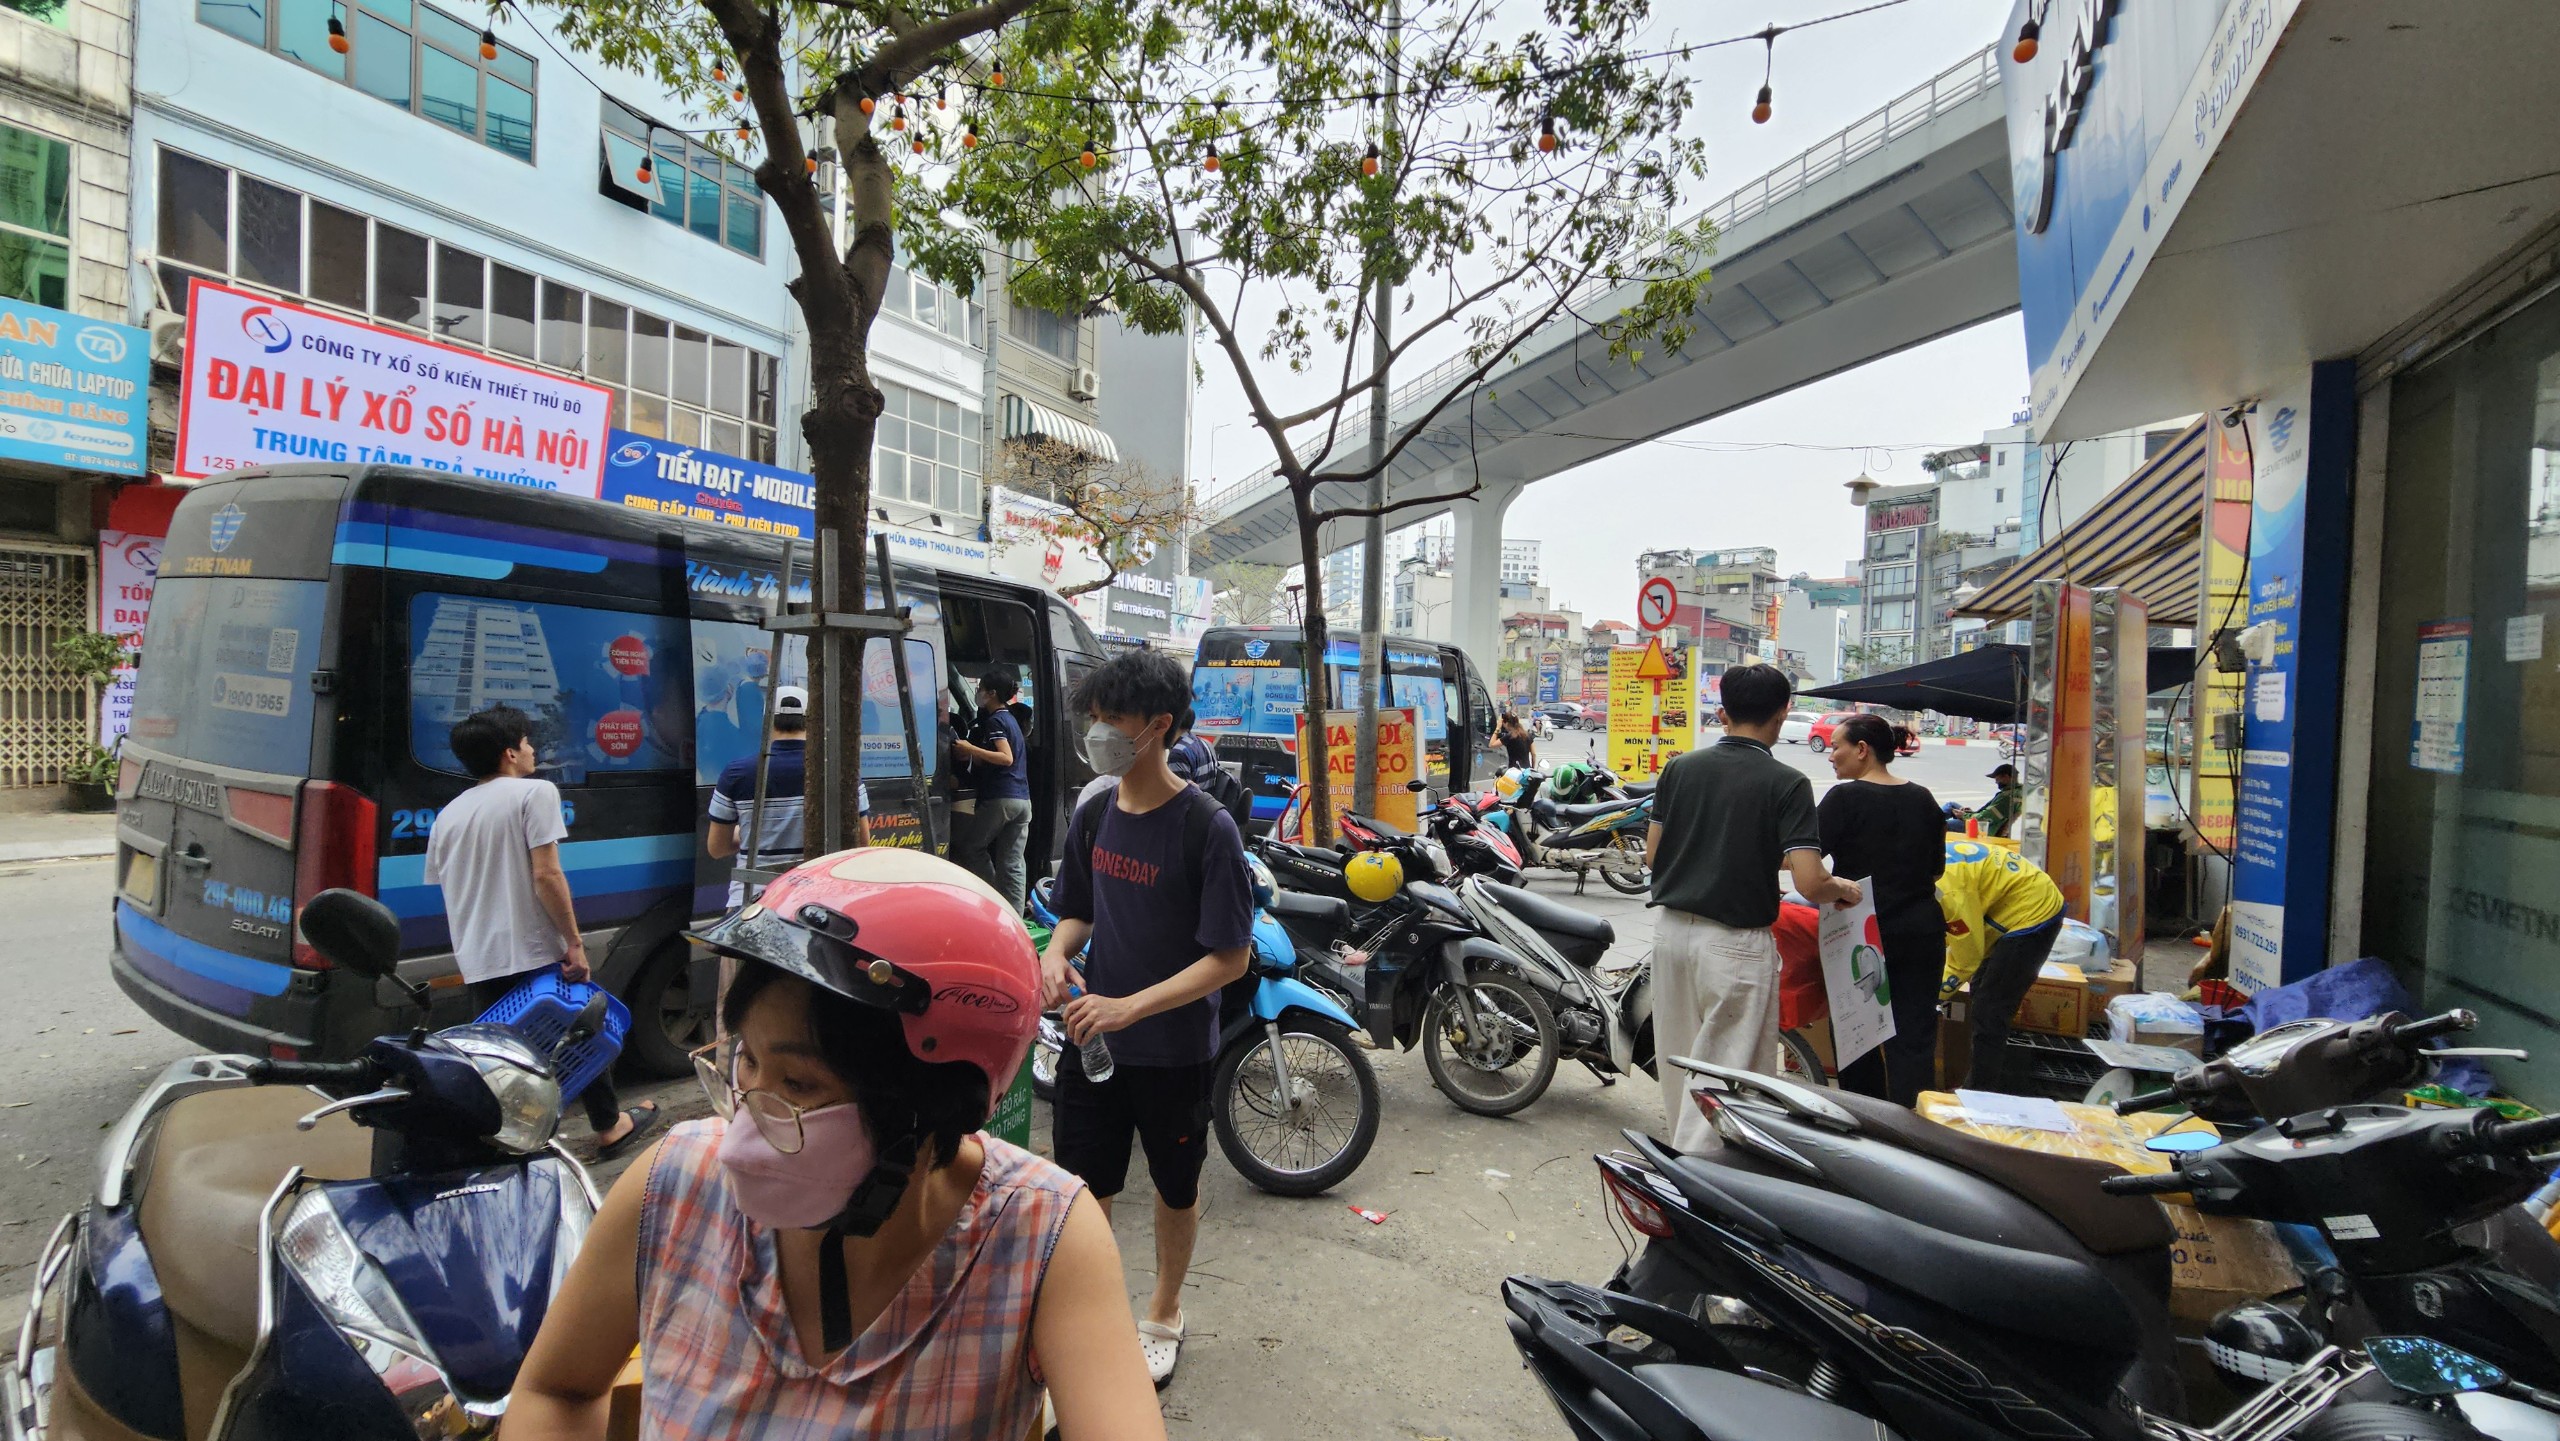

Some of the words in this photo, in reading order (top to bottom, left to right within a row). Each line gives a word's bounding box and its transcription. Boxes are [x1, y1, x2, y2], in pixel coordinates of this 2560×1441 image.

[29, 360, 72, 390] CHỮA
[77, 371, 136, 401] LAPTOP
[302, 335, 355, 360] CÔNG
[361, 348, 381, 366] TY
[387, 353, 412, 373] XỔ
[417, 362, 440, 380] SỐ
[445, 370, 482, 391] KIẾN
[488, 383, 528, 402] THIẾT
[533, 391, 559, 409] THỦ
[563, 399, 582, 414] ĐÔ
[207, 356, 286, 416] ĐẠI
[300, 375, 350, 423] LÝ
[359, 385, 417, 434] XỔ
[424, 401, 476, 446] SỐ
[481, 416, 525, 458] HÀ
[536, 429, 589, 475] NỘI
[63, 430, 129, 448] lenovo
[253, 427, 347, 462] TRUNG
[202, 456, 236, 470] 125
[656, 446, 703, 486] TIẾN
[703, 463, 744, 497] ĐẠT
[753, 474, 816, 510] MOBILE
[624, 494, 658, 511] CUNG
[688, 508, 714, 522] LINH
[930, 541, 954, 556] THOẠI
[227, 689, 253, 707] 1900
[256, 693, 284, 711] 1965
[863, 742, 882, 750] 1900
[884, 741, 901, 750] 1965
[144, 768, 218, 808] LIMOUSINE
[230, 918, 282, 940] SOLATI
[435, 1183, 501, 1200] HONDA
